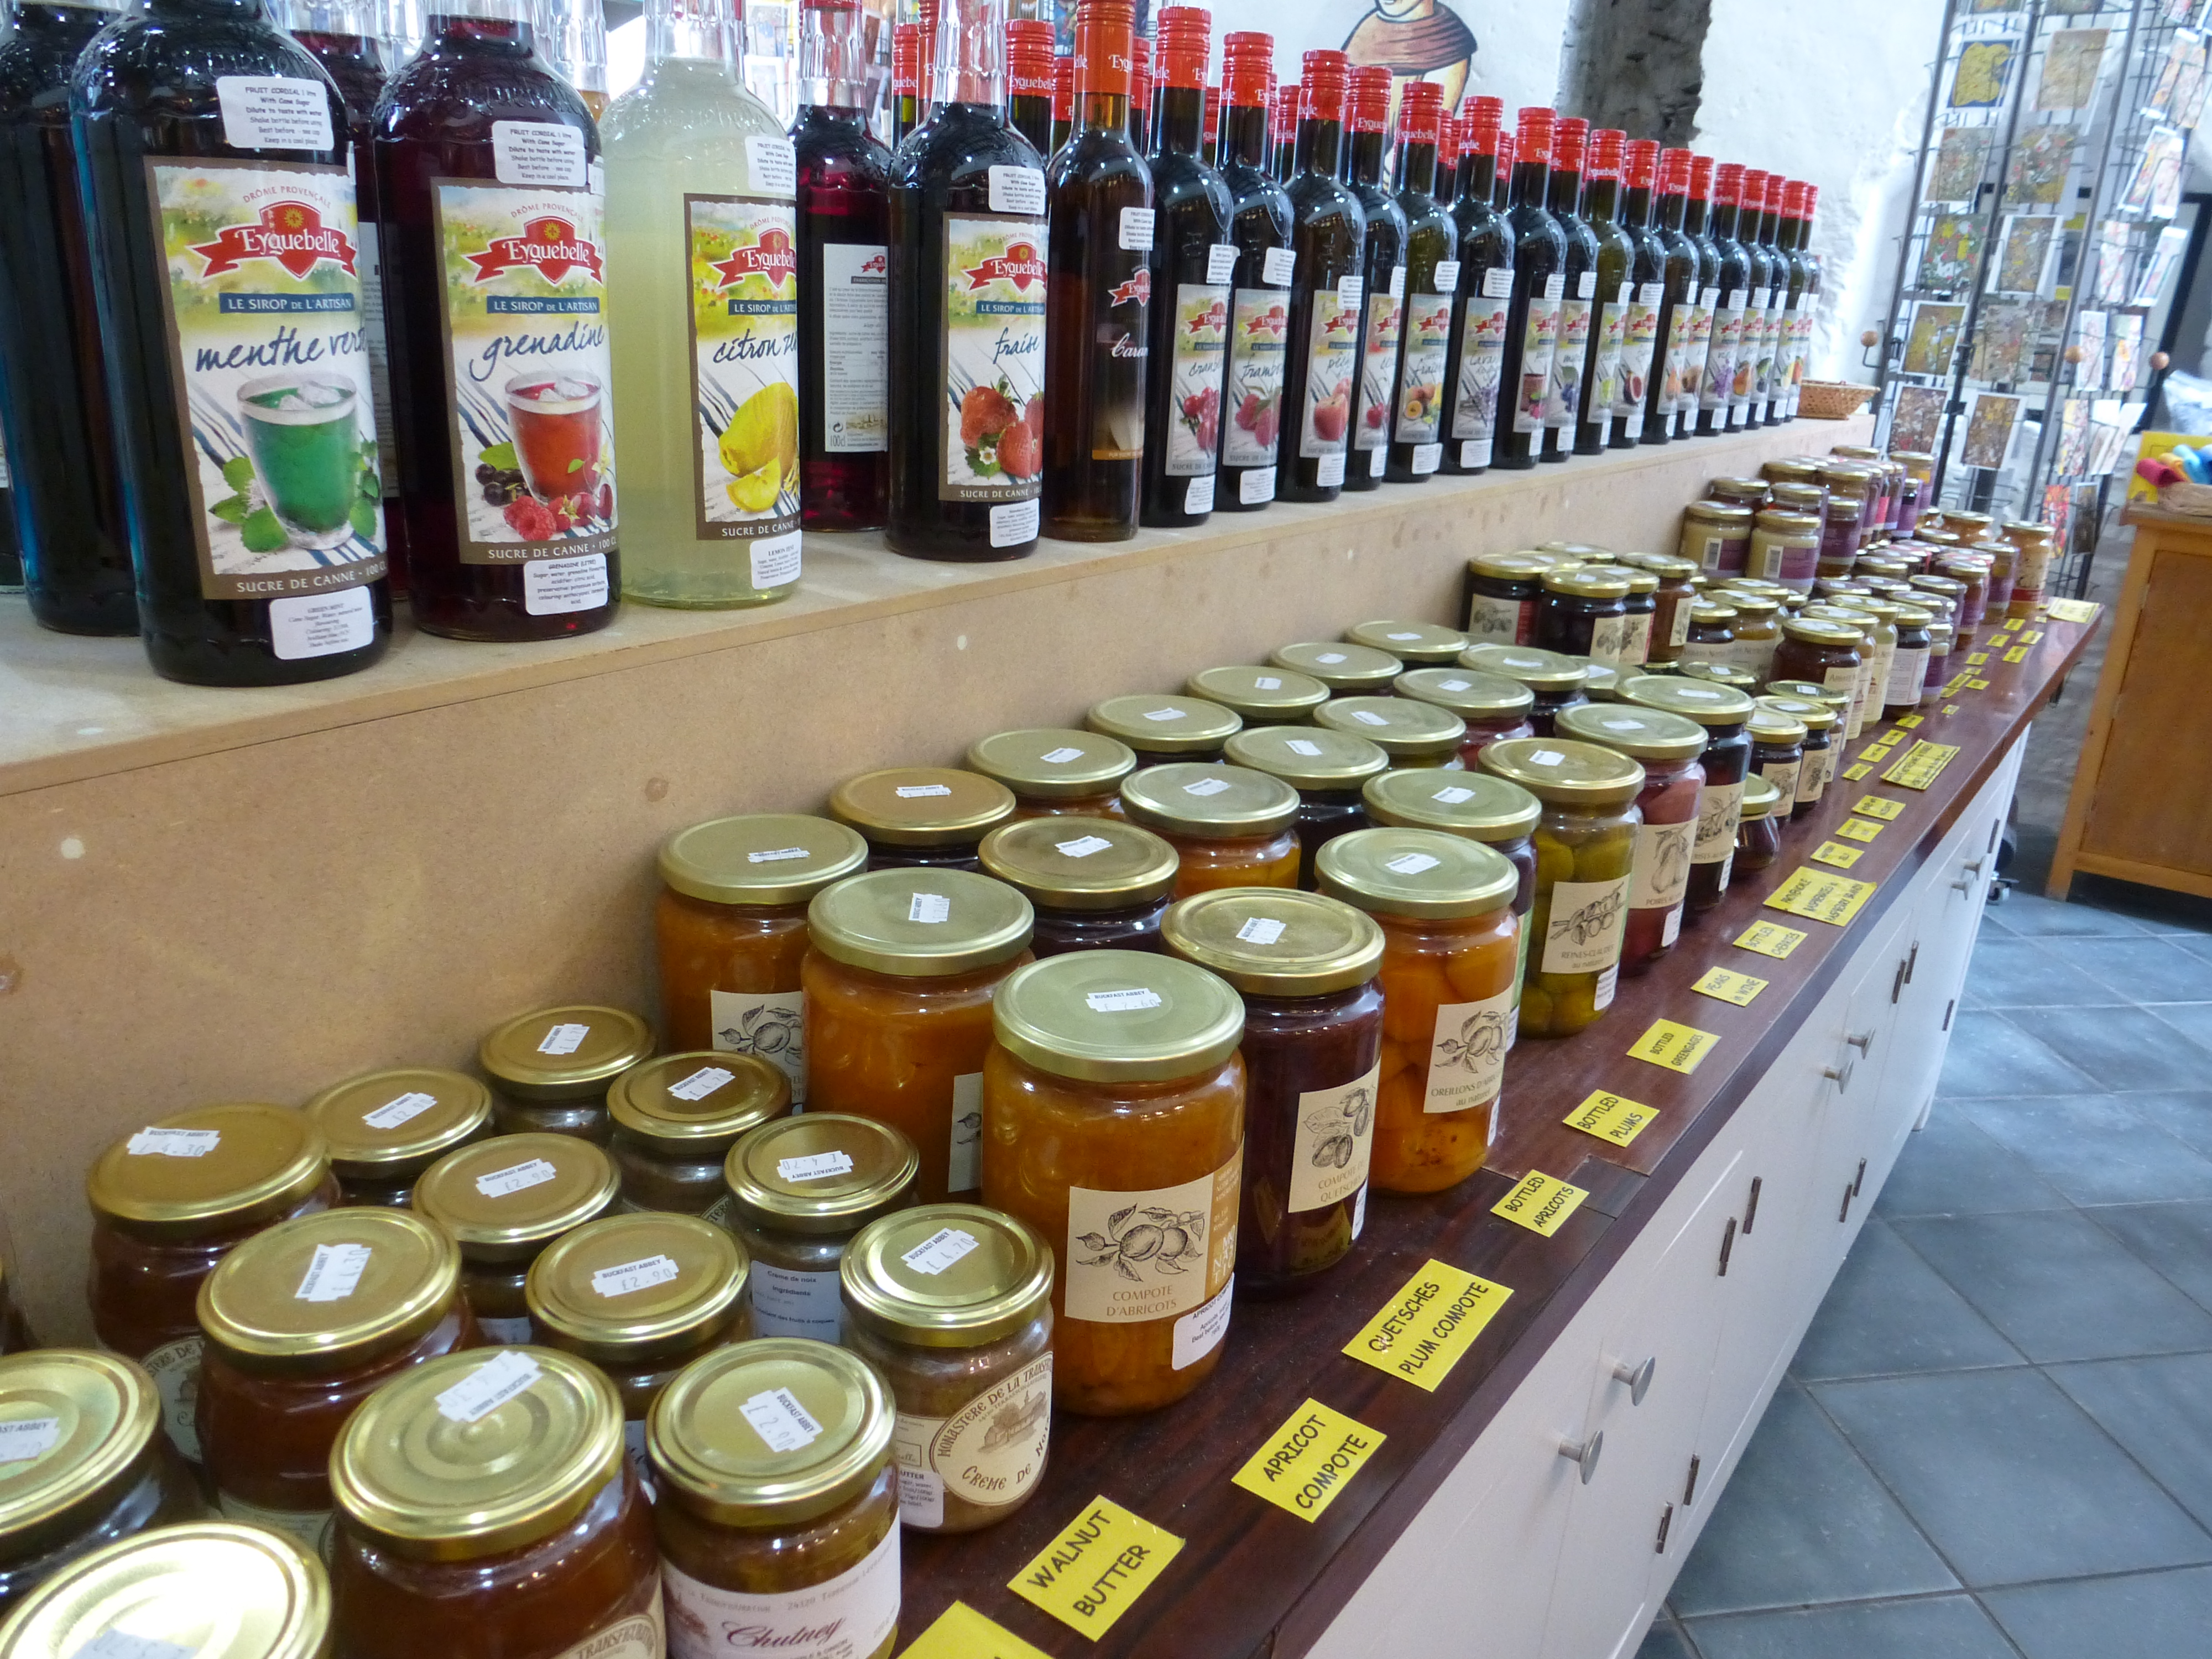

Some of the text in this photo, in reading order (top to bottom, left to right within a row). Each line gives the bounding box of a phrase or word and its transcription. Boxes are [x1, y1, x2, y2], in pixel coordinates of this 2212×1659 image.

[271, 87, 300, 96] CORDIAL
[510, 204, 540, 218] DRÔME
[234, 227, 341, 257] Eyguebelle
[502, 239, 591, 265] Eyguebelle
[228, 299, 245, 310] LE
[248, 299, 288, 310] SIROP
[305, 298, 352, 310] L'ARTISAN
[494, 301, 507, 310] LE
[510, 302, 544, 311] SIROP
[559, 301, 598, 312] L'ARTISAN
[735, 304, 771, 314] LE SIROP
[982, 304, 1015, 313] LE SIROP
[196, 325, 326, 374] menthe
[713, 328, 780, 364] citron
[993, 327, 1040, 364] fraise
[960, 488, 1029, 498] SUCRE DE CANNE
[722, 528, 754, 537] SUCRE
[758, 526, 769, 535] DE
[488, 549, 528, 559] SUCRE
[533, 549, 549, 558] DE
[553, 544, 589, 556] CANNE
[236, 570, 356, 593] SUCRE DE CANNE
[1705, 973, 1731, 992] PEARS
[1740, 977, 1761, 995] WINE
[1650, 1031, 1674, 1056] BOTTLED
[1671, 1034, 1704, 1066] GREENGAGES
[674, 1069, 711, 1091] BUCKFAST ABBEY
[1431, 1083, 1475, 1097] OREILLONS
[1455, 1089, 1490, 1107] au naturel
[1577, 1096, 1619, 1130] BOTTLED
[1610, 1113, 1644, 1140] PLUMS
[484, 1162, 538, 1182] BUCKFAST ABBEY
[813, 1166, 844, 1176] BUCKFAST
[1504, 1176, 1546, 1212] BOTTLED
[1532, 1186, 1575, 1228] APRICOTS
[908, 1232, 951, 1260] BUCKFAST ABBEY
[602, 1259, 661, 1279] BUCKFAST ABBEY
[1113, 1285, 1173, 1301] COMPOTE
[1107, 1299, 1177, 1317] D'ABRICOTS
[1368, 1281, 1440, 1352] QUETSCHES
[1399, 1281, 1489, 1375] PLUM COMPOTE
[987, 1387, 1006, 1406] DE
[1007, 1375, 1020, 1393] LA
[776, 1393, 816, 1434] BUCKFAST ABBEY
[1262, 1413, 1327, 1482] APRICOT
[962, 1463, 1031, 1491] CREME DE
[1296, 1433, 1369, 1509] COMPOTE
[1025, 1508, 1112, 1590] WALNUT
[1073, 1543, 1151, 1617] BUTTER
[721, 1617, 846, 1648] Chutney
